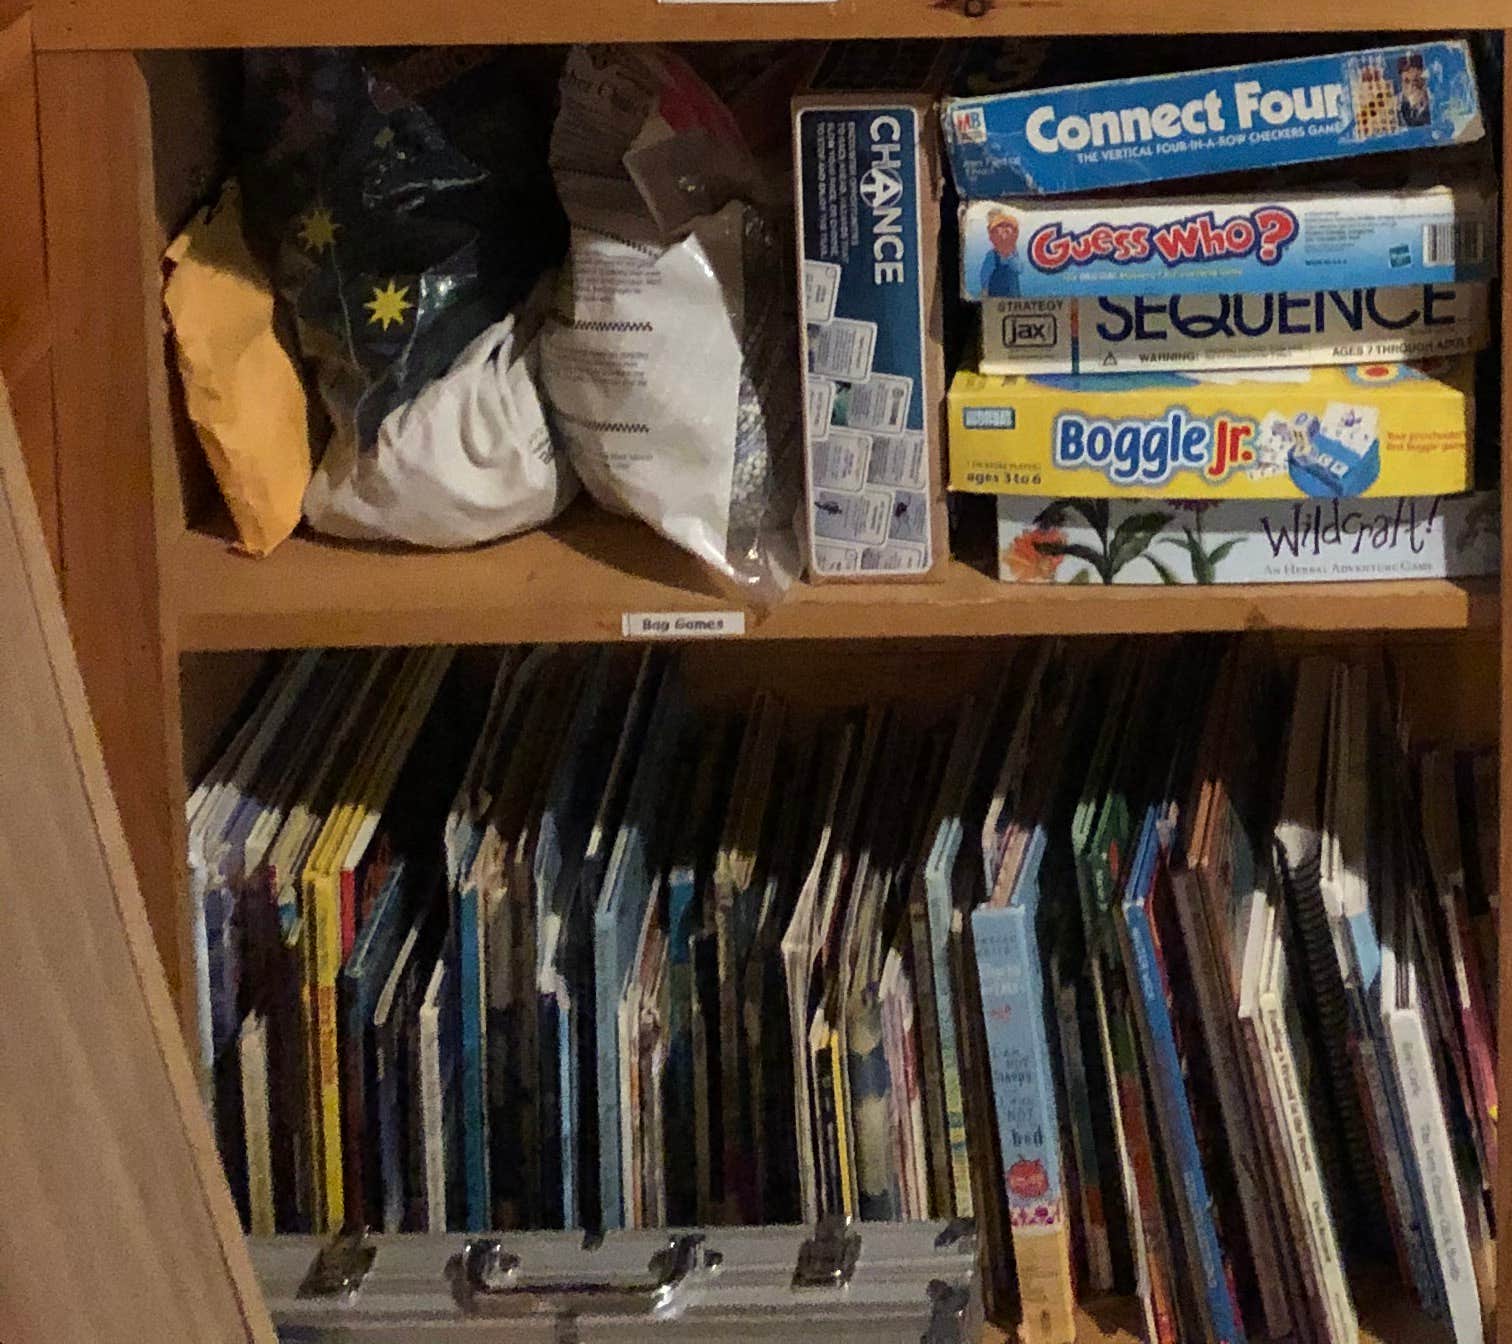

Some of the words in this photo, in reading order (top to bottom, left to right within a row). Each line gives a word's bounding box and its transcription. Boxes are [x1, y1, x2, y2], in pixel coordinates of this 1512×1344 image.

[1024, 92, 1227, 153] Connect
[1233, 77, 1345, 127] Four
[1076, 151, 1100, 165] THE
[868, 114, 905, 286] CHANCE
[1031, 223, 1150, 268] Guess
[1155, 210, 1297, 265] Who?
[997, 298, 1064, 311] STRATEGY
[1097, 282, 1457, 341] SEQUENCE
[1060, 414, 1205, 480] Boggle
[1209, 421, 1254, 476] Jr.
[641, 617, 669, 633] Bag
[674, 616, 725, 632] Games
